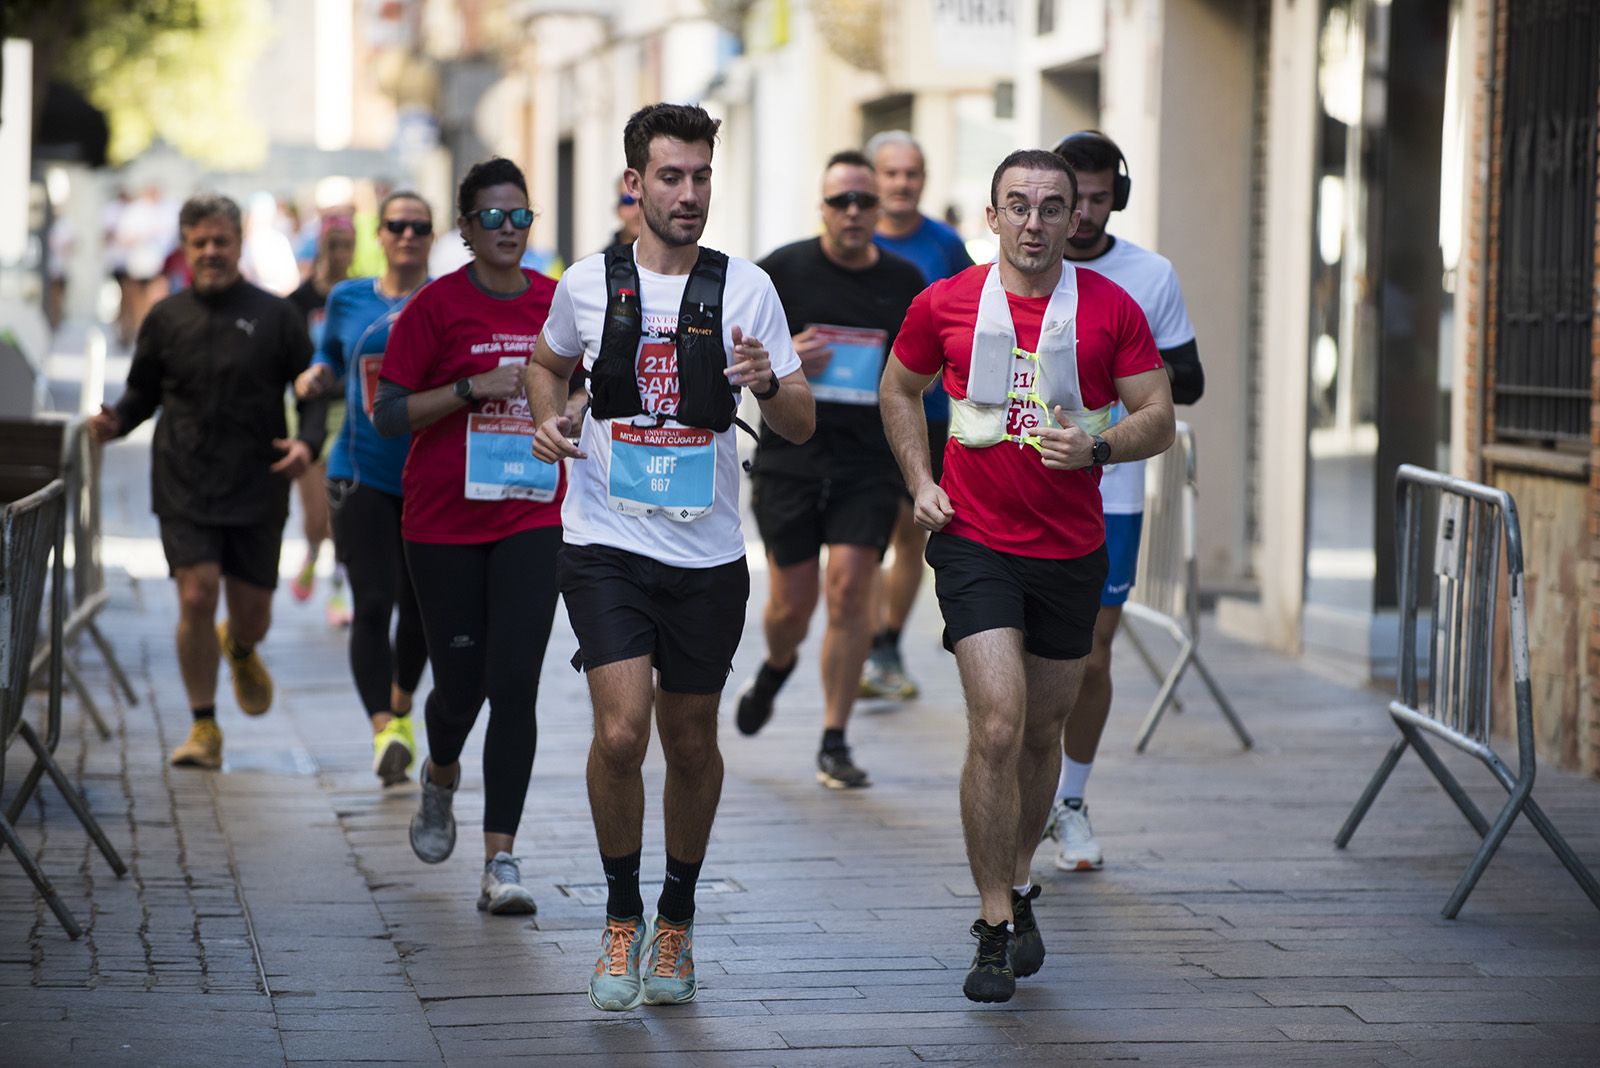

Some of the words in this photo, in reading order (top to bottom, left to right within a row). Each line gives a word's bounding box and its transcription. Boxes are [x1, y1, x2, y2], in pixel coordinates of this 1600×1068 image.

[643, 315, 677, 324] NIVER
[637, 376, 680, 395] SAN
[619, 431, 642, 443] MITJA
[644, 435, 666, 444] SANT
[667, 435, 695, 444] CUGAT
[696, 435, 706, 444] 23
[646, 455, 678, 474] JEFF
[650, 478, 671, 492] 667
